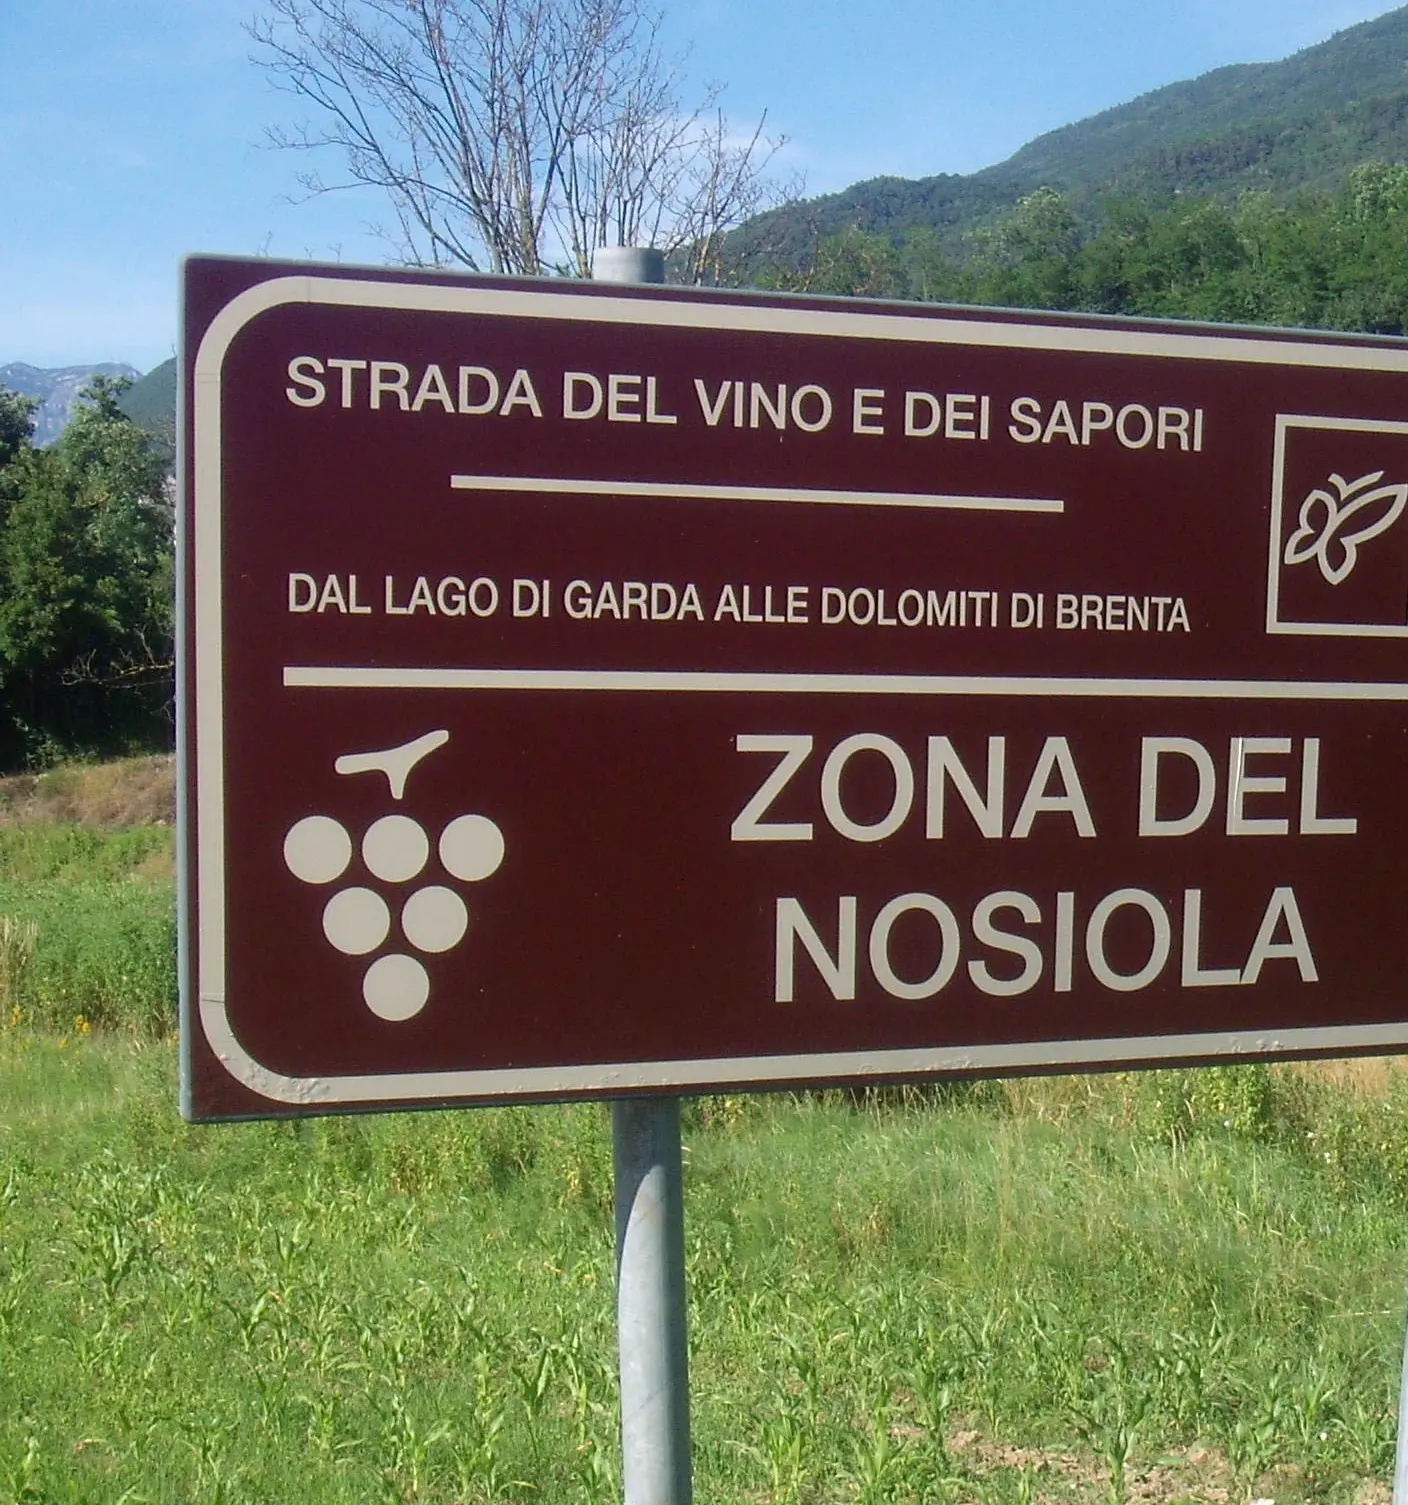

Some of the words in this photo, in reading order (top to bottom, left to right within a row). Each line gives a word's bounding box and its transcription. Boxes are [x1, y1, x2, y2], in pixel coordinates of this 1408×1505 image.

[286, 356, 542, 419] STRADA
[564, 372, 677, 424] DEL
[694, 379, 832, 432] VINO
[853, 389, 884, 434] E
[905, 392, 989, 440] DEI
[1009, 397, 1203, 452] SAPORI
[289, 573, 371, 613] DAL
[386, 576, 498, 617] LAGO
[513, 579, 549, 618] DI
[565, 580, 700, 620] GARDA
[714, 585, 808, 623] ALLE
[822, 587, 998, 627] DOLOMITI
[1012, 593, 1043, 628] DI
[1057, 594, 1191, 632] BRENTA
[731, 733, 1096, 843] ZONA
[1139, 736, 1358, 837] DEL
[776, 886, 1319, 1003] NOSIOLA
